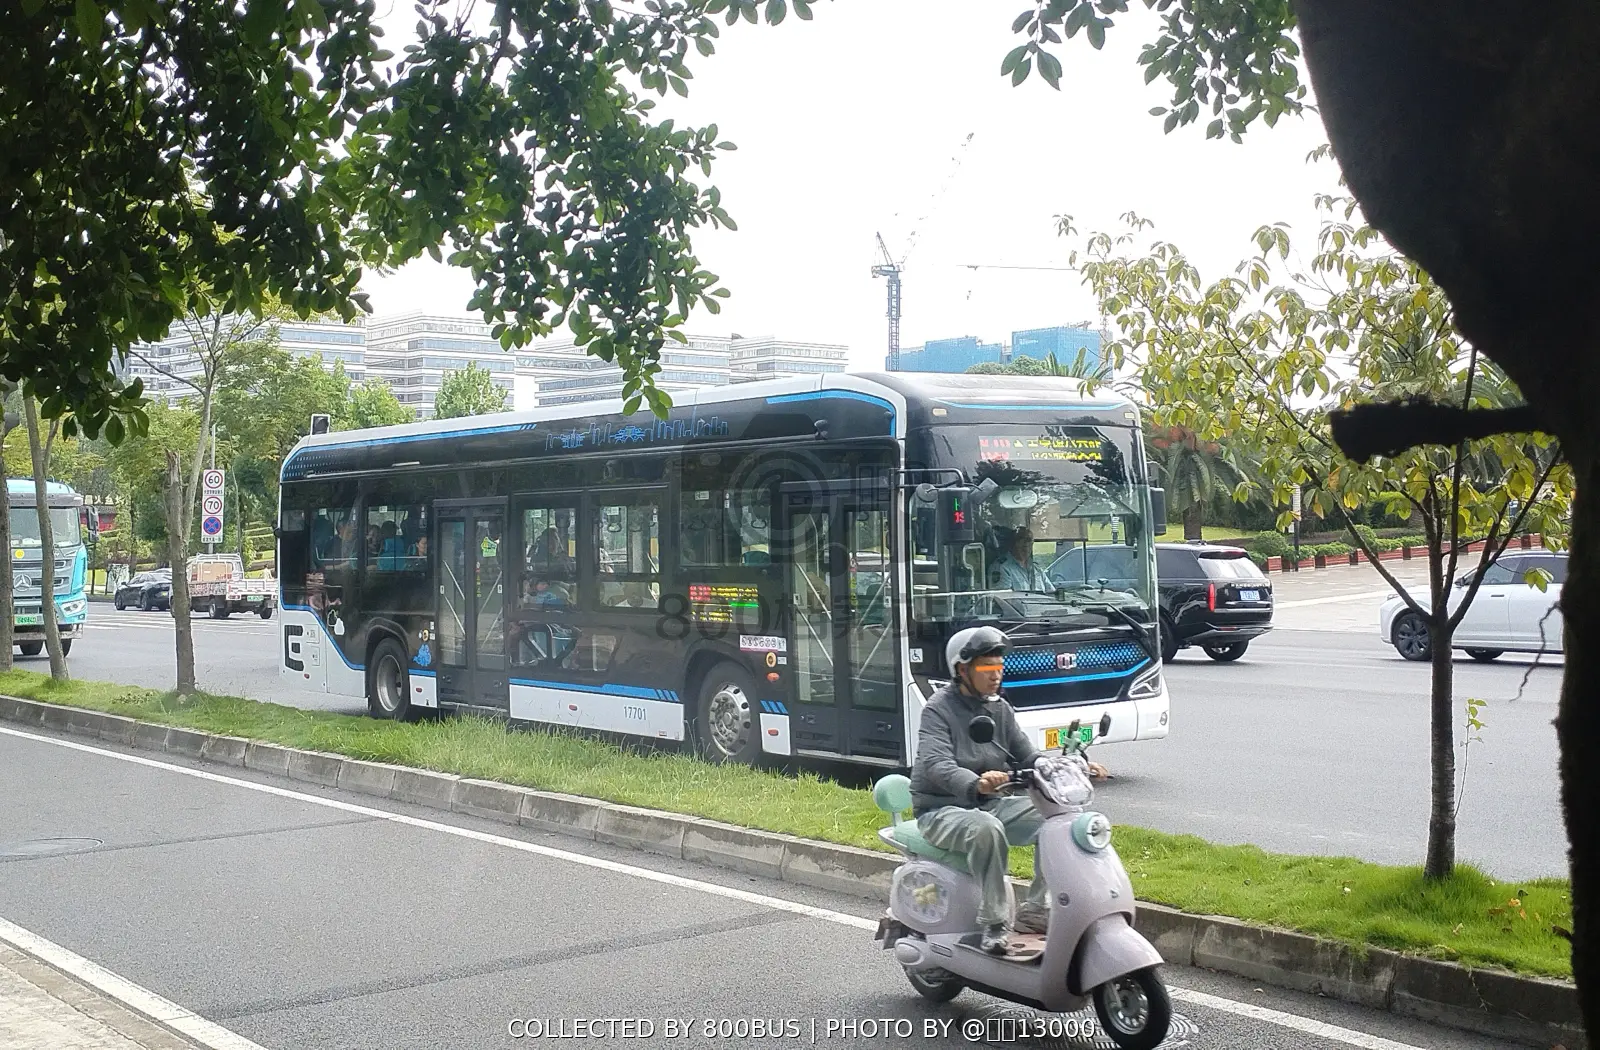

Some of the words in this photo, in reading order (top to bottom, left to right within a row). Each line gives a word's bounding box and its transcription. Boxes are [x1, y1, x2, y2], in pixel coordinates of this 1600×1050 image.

[208, 475, 220, 485] 60
[207, 501, 220, 510] 70
[623, 706, 647, 721] 17701
